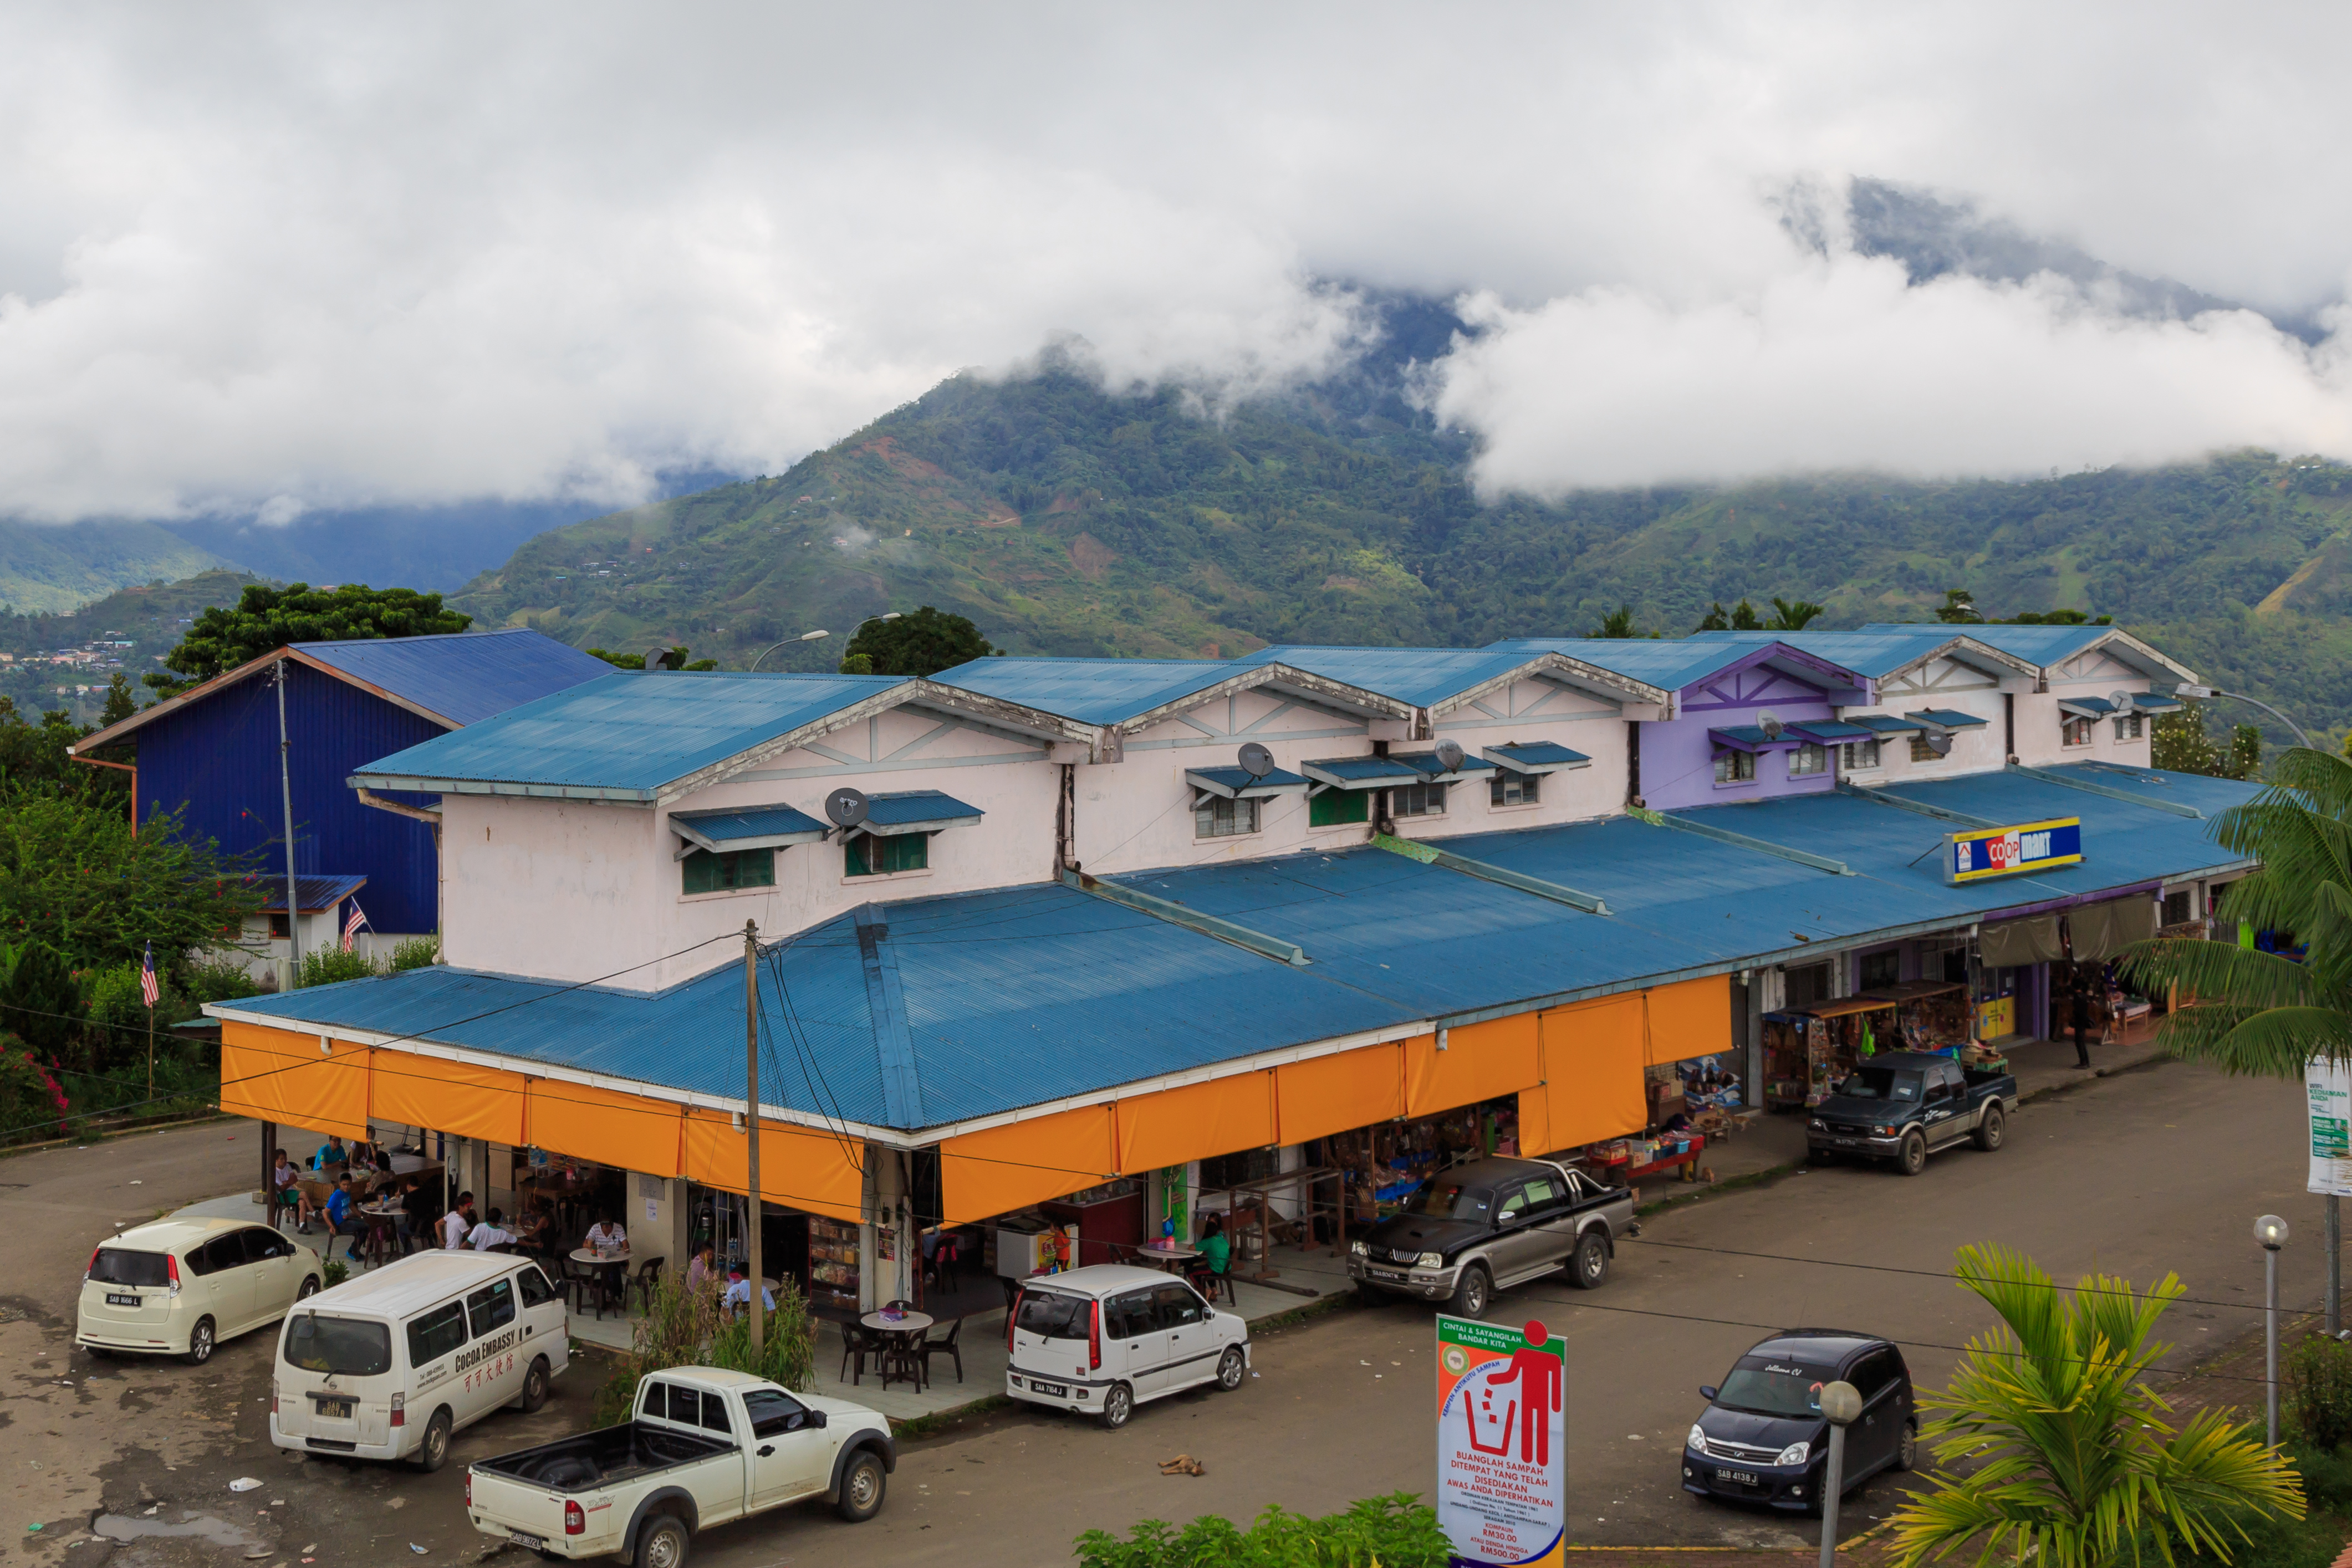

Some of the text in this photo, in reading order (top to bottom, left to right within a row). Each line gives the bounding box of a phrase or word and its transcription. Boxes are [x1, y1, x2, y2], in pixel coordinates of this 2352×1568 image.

[1990, 841, 2019, 862] COOP
[2309, 1089, 2347, 1097] KEDIAMAN
[1443, 1322, 1466, 1332] CINTAI
[1476, 1328, 1522, 1343] SAYANGILAH
[1458, 1333, 1507, 1349] BANDAR KITA
[456, 1330, 515, 1373] COCOA EMBASSY
[1442, 1361, 1500, 1417] KEMPEN ANTIKUTU SAMPAH
[1457, 1451, 1543, 1475] BUANGLAH SAMPAH
[1451, 1460, 1548, 1487] DITEMPAT YANG TELAH
[1718, 1469, 1731, 1478] SAB
[1475, 1475, 1527, 1493] DISEDIAKAN
[1447, 1479, 1553, 1508] AWAS ANDA DIPERHATIKAN
[1505, 1501, 1527, 1509] TEMPATAN
[1483, 1529, 1517, 1543] RM30.00
[1485, 1523, 1513, 1533] KOMPAUN
[511, 1532, 522, 1542] SAB
[537, 1539, 540, 1547] L
[1486, 1540, 1504, 1549] DENDA
[1506, 1545, 1528, 1554] HINGGA
[1481, 1545, 1519, 1561] RM500.00
